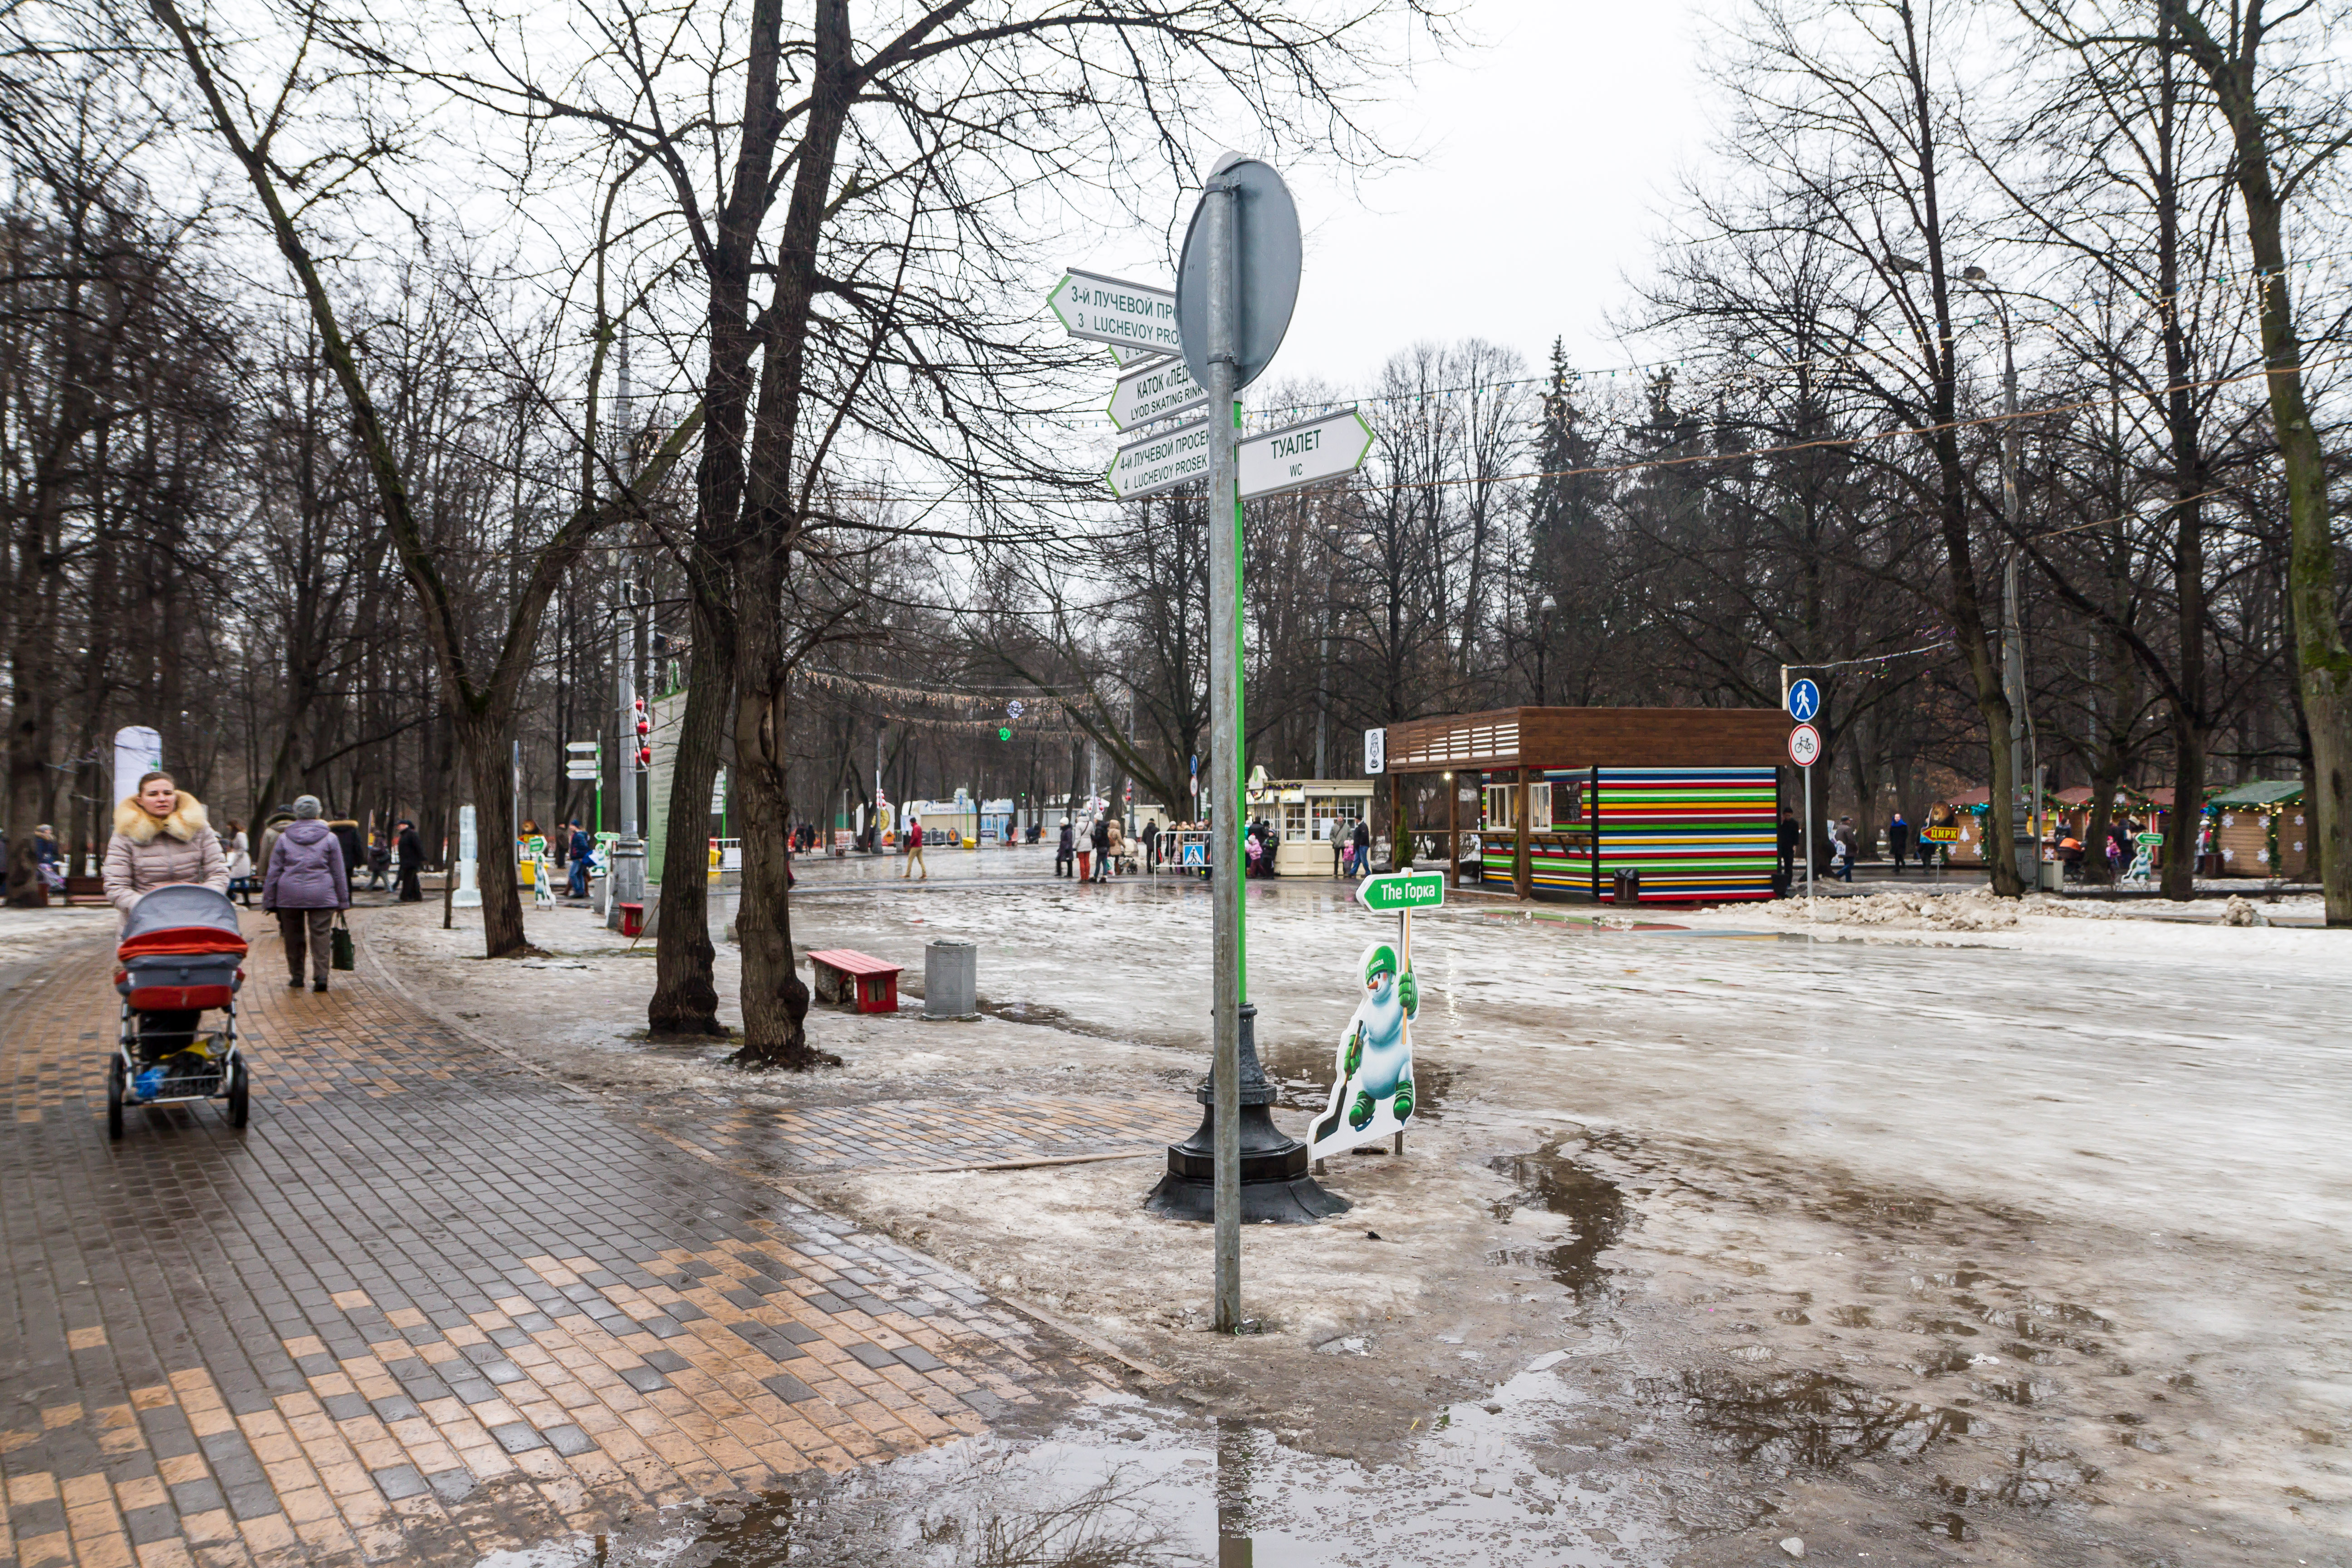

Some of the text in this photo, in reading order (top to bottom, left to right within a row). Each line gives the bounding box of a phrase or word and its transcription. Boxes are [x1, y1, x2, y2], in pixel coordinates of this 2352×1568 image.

[1093, 290, 1153, 317] ЛУЧЕВОЙ
[1156, 302, 1176, 319] ПР
[1078, 313, 1084, 328] 3
[1094, 315, 1153, 340] LUCHEVOY
[1137, 373, 1164, 400] КАТОК
[1131, 385, 1203, 421] LYOD SKATING RINK
[1134, 438, 1173, 467] ЛУЧЕВОЙ
[1271, 429, 1321, 459] ТУАЛЕТ
[1124, 453, 1207, 491] 4 LUCHEVOY PROSEK
[1289, 463, 1303, 477] WC
[1931, 829, 1957, 839] ЦИРК
[1381, 882, 1436, 902] The Горка
